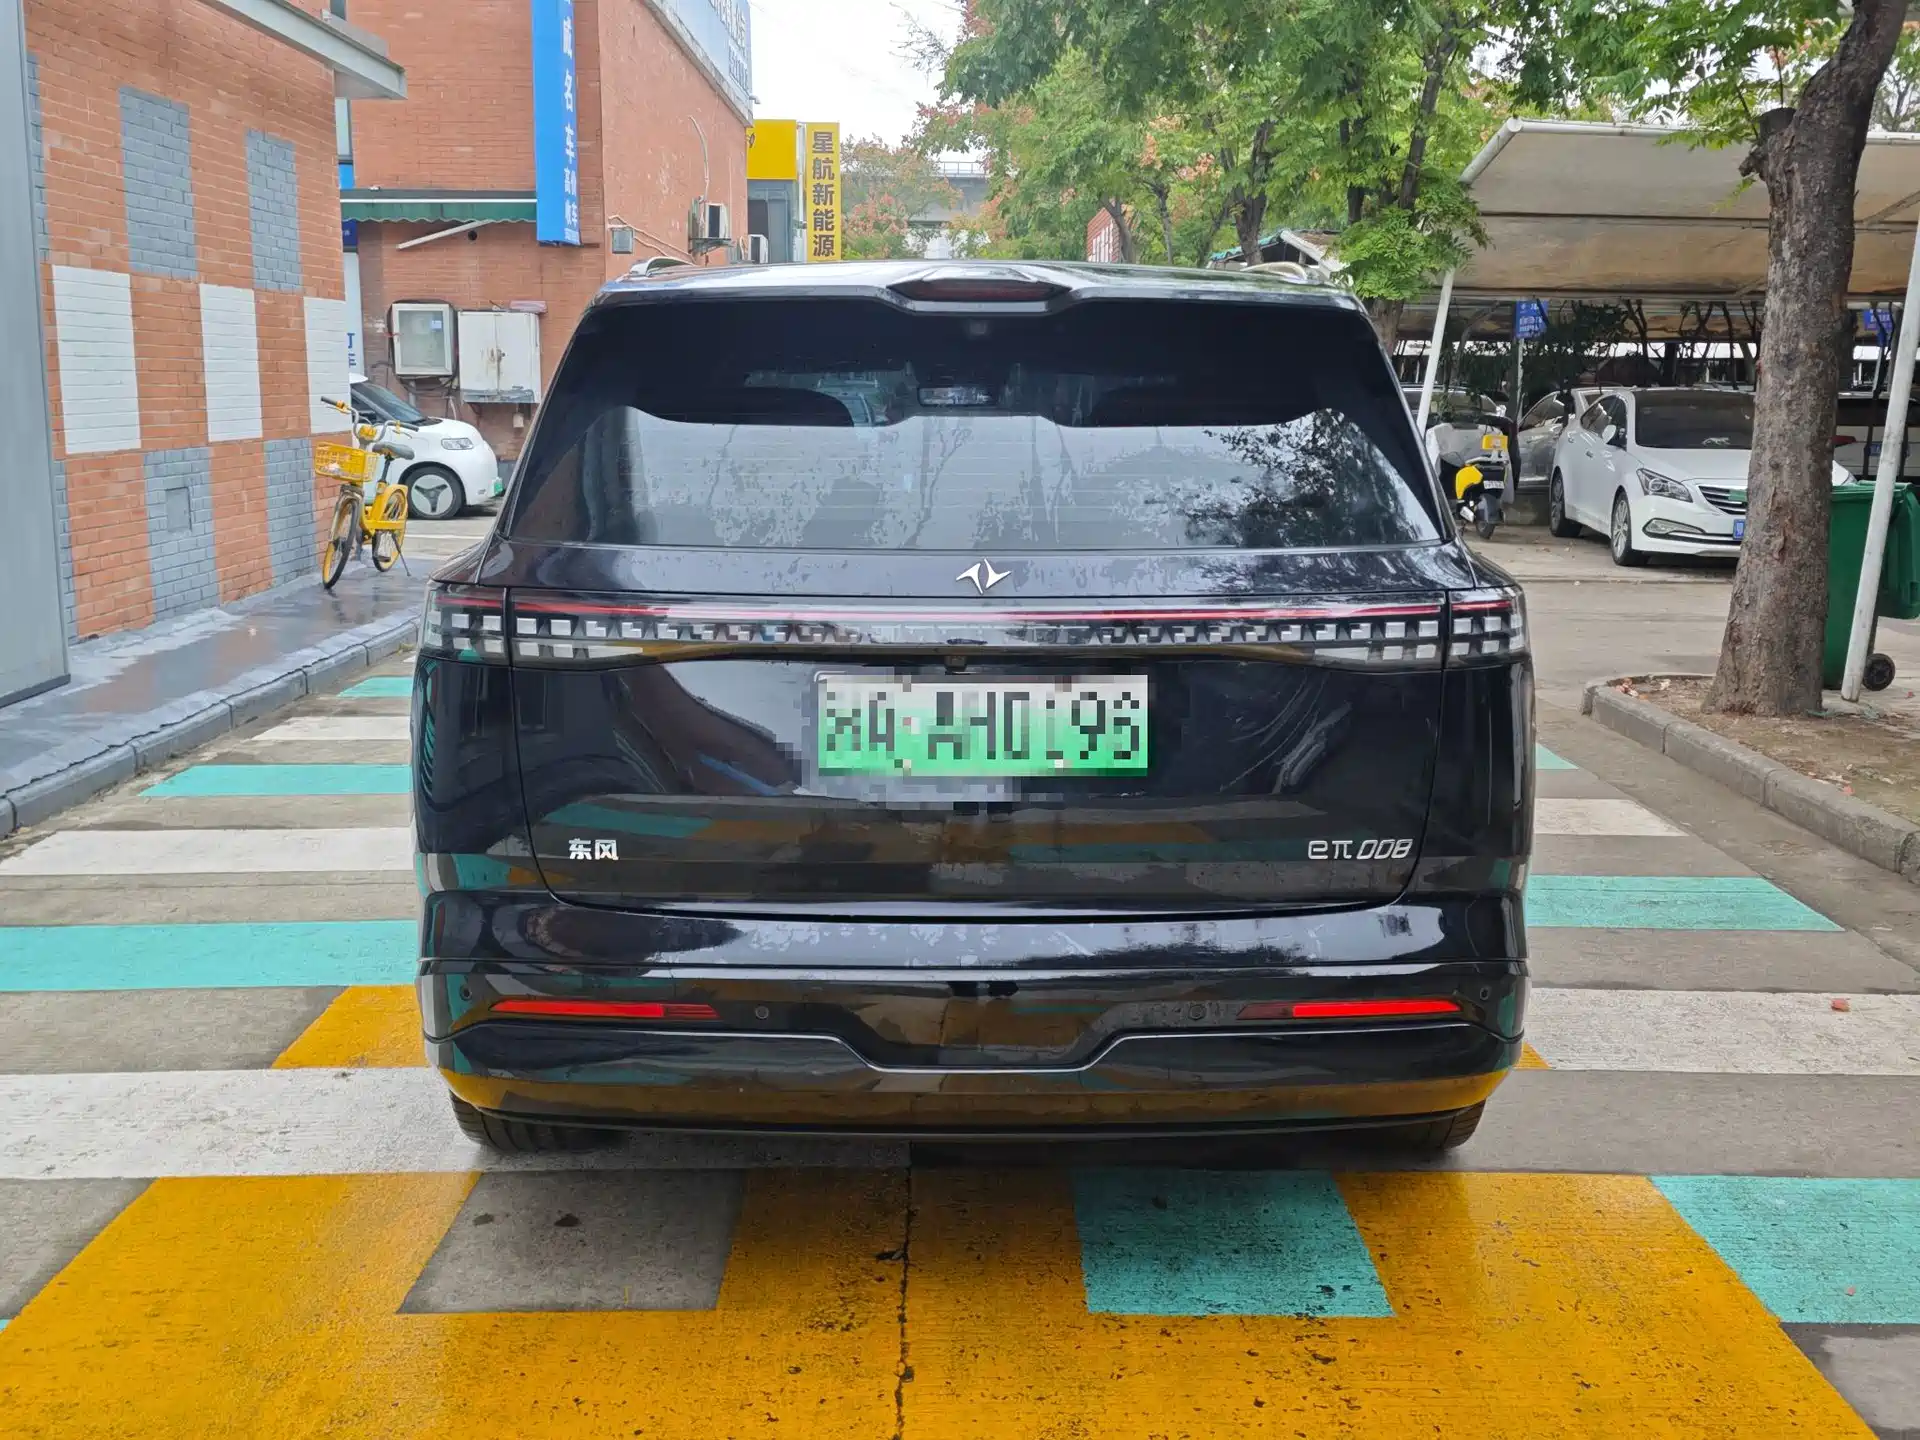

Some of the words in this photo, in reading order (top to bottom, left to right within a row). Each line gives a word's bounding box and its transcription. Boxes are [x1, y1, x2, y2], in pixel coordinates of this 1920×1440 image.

[812, 131, 835, 257] 星航新能源
[568, 838, 619, 860] 东风
